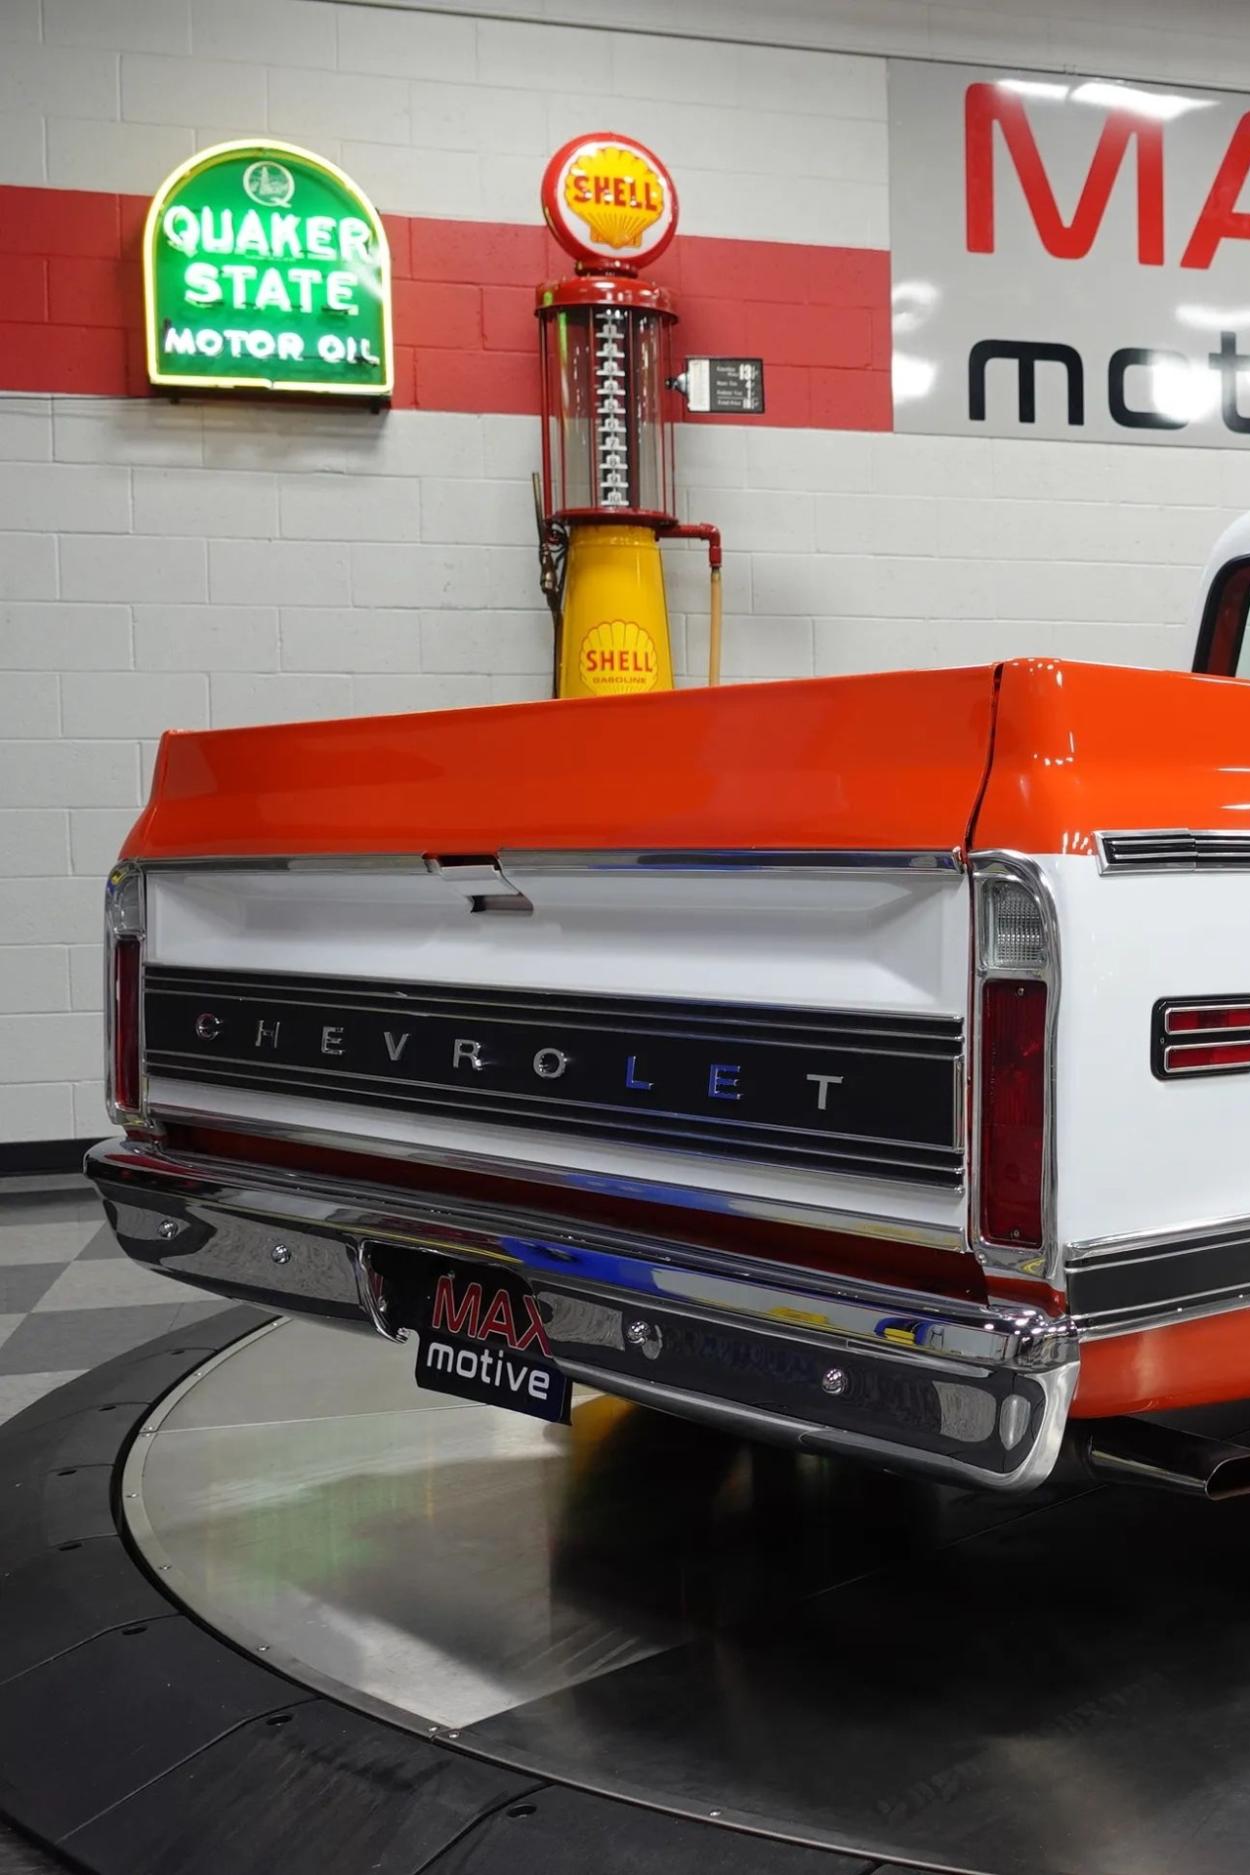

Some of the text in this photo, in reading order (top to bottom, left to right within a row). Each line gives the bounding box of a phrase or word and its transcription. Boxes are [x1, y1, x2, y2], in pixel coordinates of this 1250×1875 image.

[573, 175, 658, 211] SHELL
[163, 205, 378, 264] QUAKER
[184, 262, 359, 315] STATE
[164, 327, 380, 365] MOTOR OIL
[586, 649, 653, 672] SHELL
[195, 1012, 844, 1110] CHEVROLET
[432, 1275, 552, 1358] MAX
[427, 1341, 550, 1400] motive
